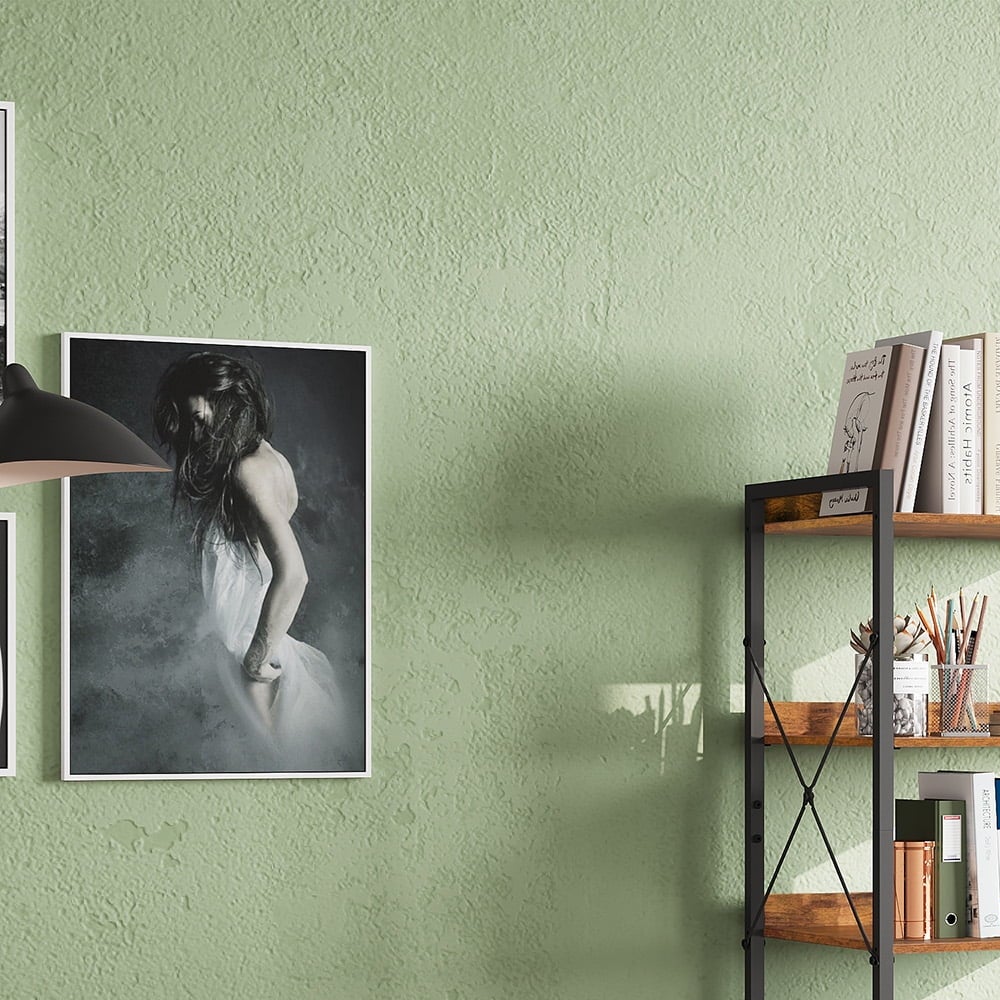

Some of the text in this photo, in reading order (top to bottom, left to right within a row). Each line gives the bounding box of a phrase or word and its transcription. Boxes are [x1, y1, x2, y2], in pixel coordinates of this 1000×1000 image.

[931, 343, 939, 354] THE
[928, 355, 937, 378] HOUND
[923, 388, 931, 400] THE
[915, 401, 928, 446] BASKERVILLES
[982, 789, 991, 829] ARCHITECTURE
